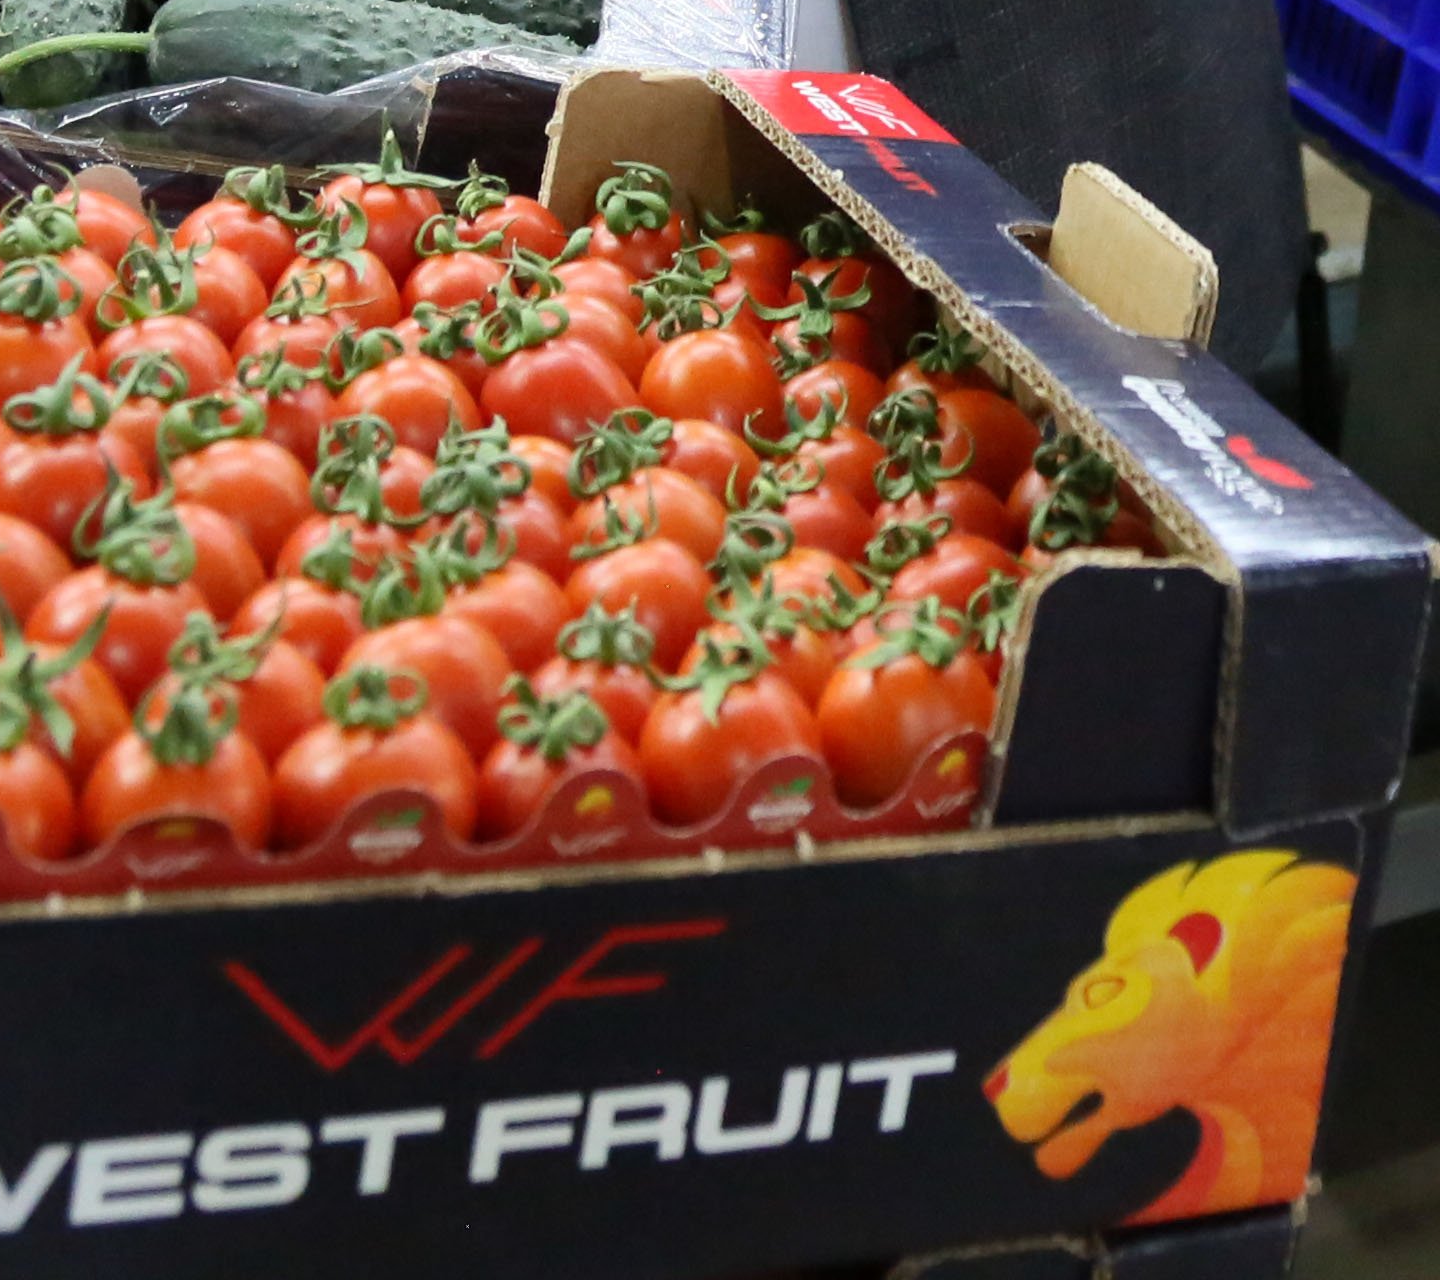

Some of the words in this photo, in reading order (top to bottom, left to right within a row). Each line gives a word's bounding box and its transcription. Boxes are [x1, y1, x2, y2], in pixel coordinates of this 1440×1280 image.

[791, 80, 870, 136] WEST
[221, 918, 728, 1072] WF
[467, 1048, 960, 1186] FRUIT
